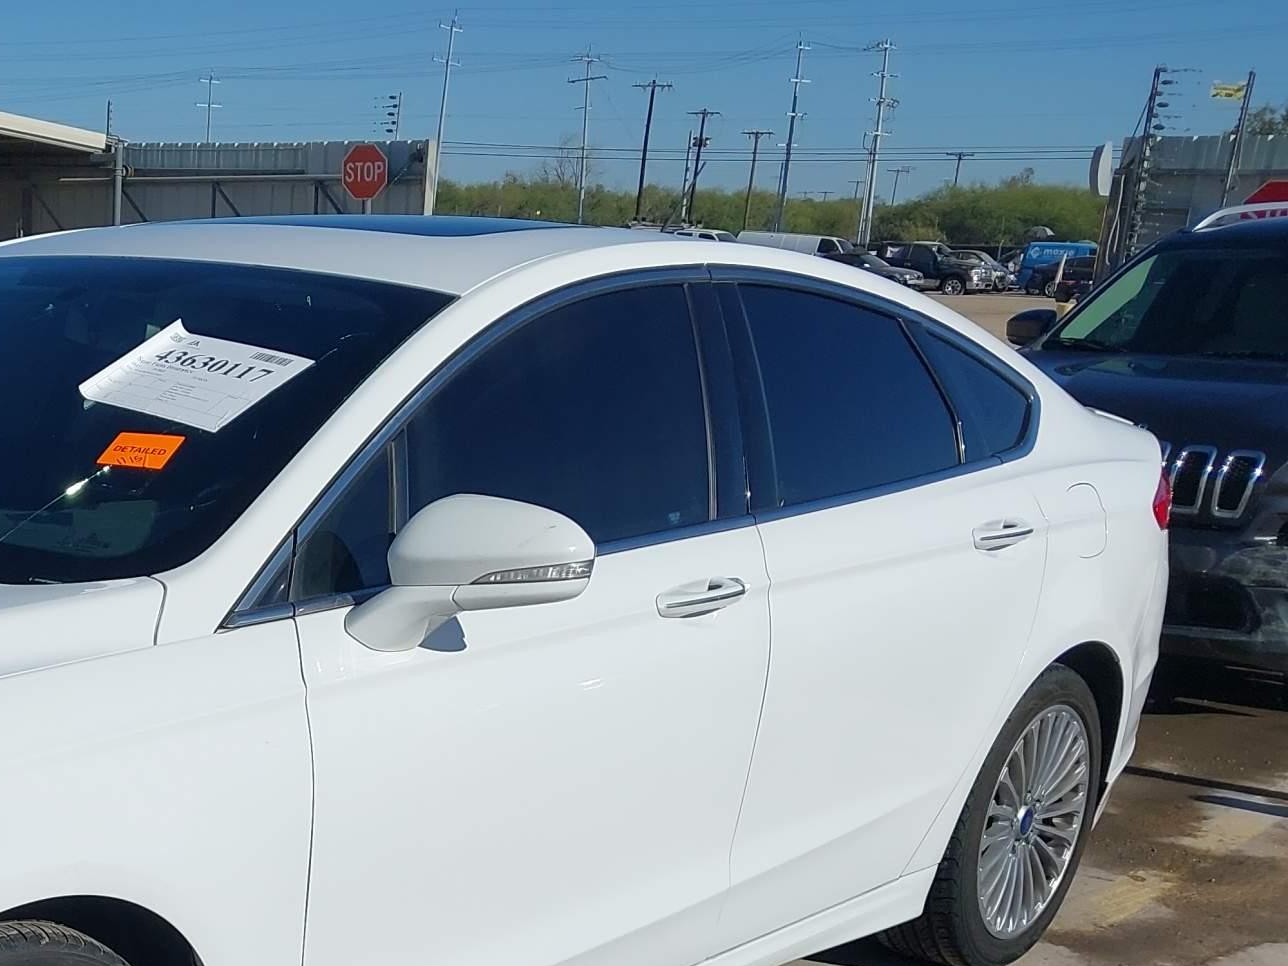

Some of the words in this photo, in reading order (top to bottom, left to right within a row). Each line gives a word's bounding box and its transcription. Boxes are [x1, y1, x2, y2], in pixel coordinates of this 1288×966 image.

[345, 162, 384, 182] STOP
[155, 349, 274, 382] 43630117
[113, 445, 167, 456] DETAILED
